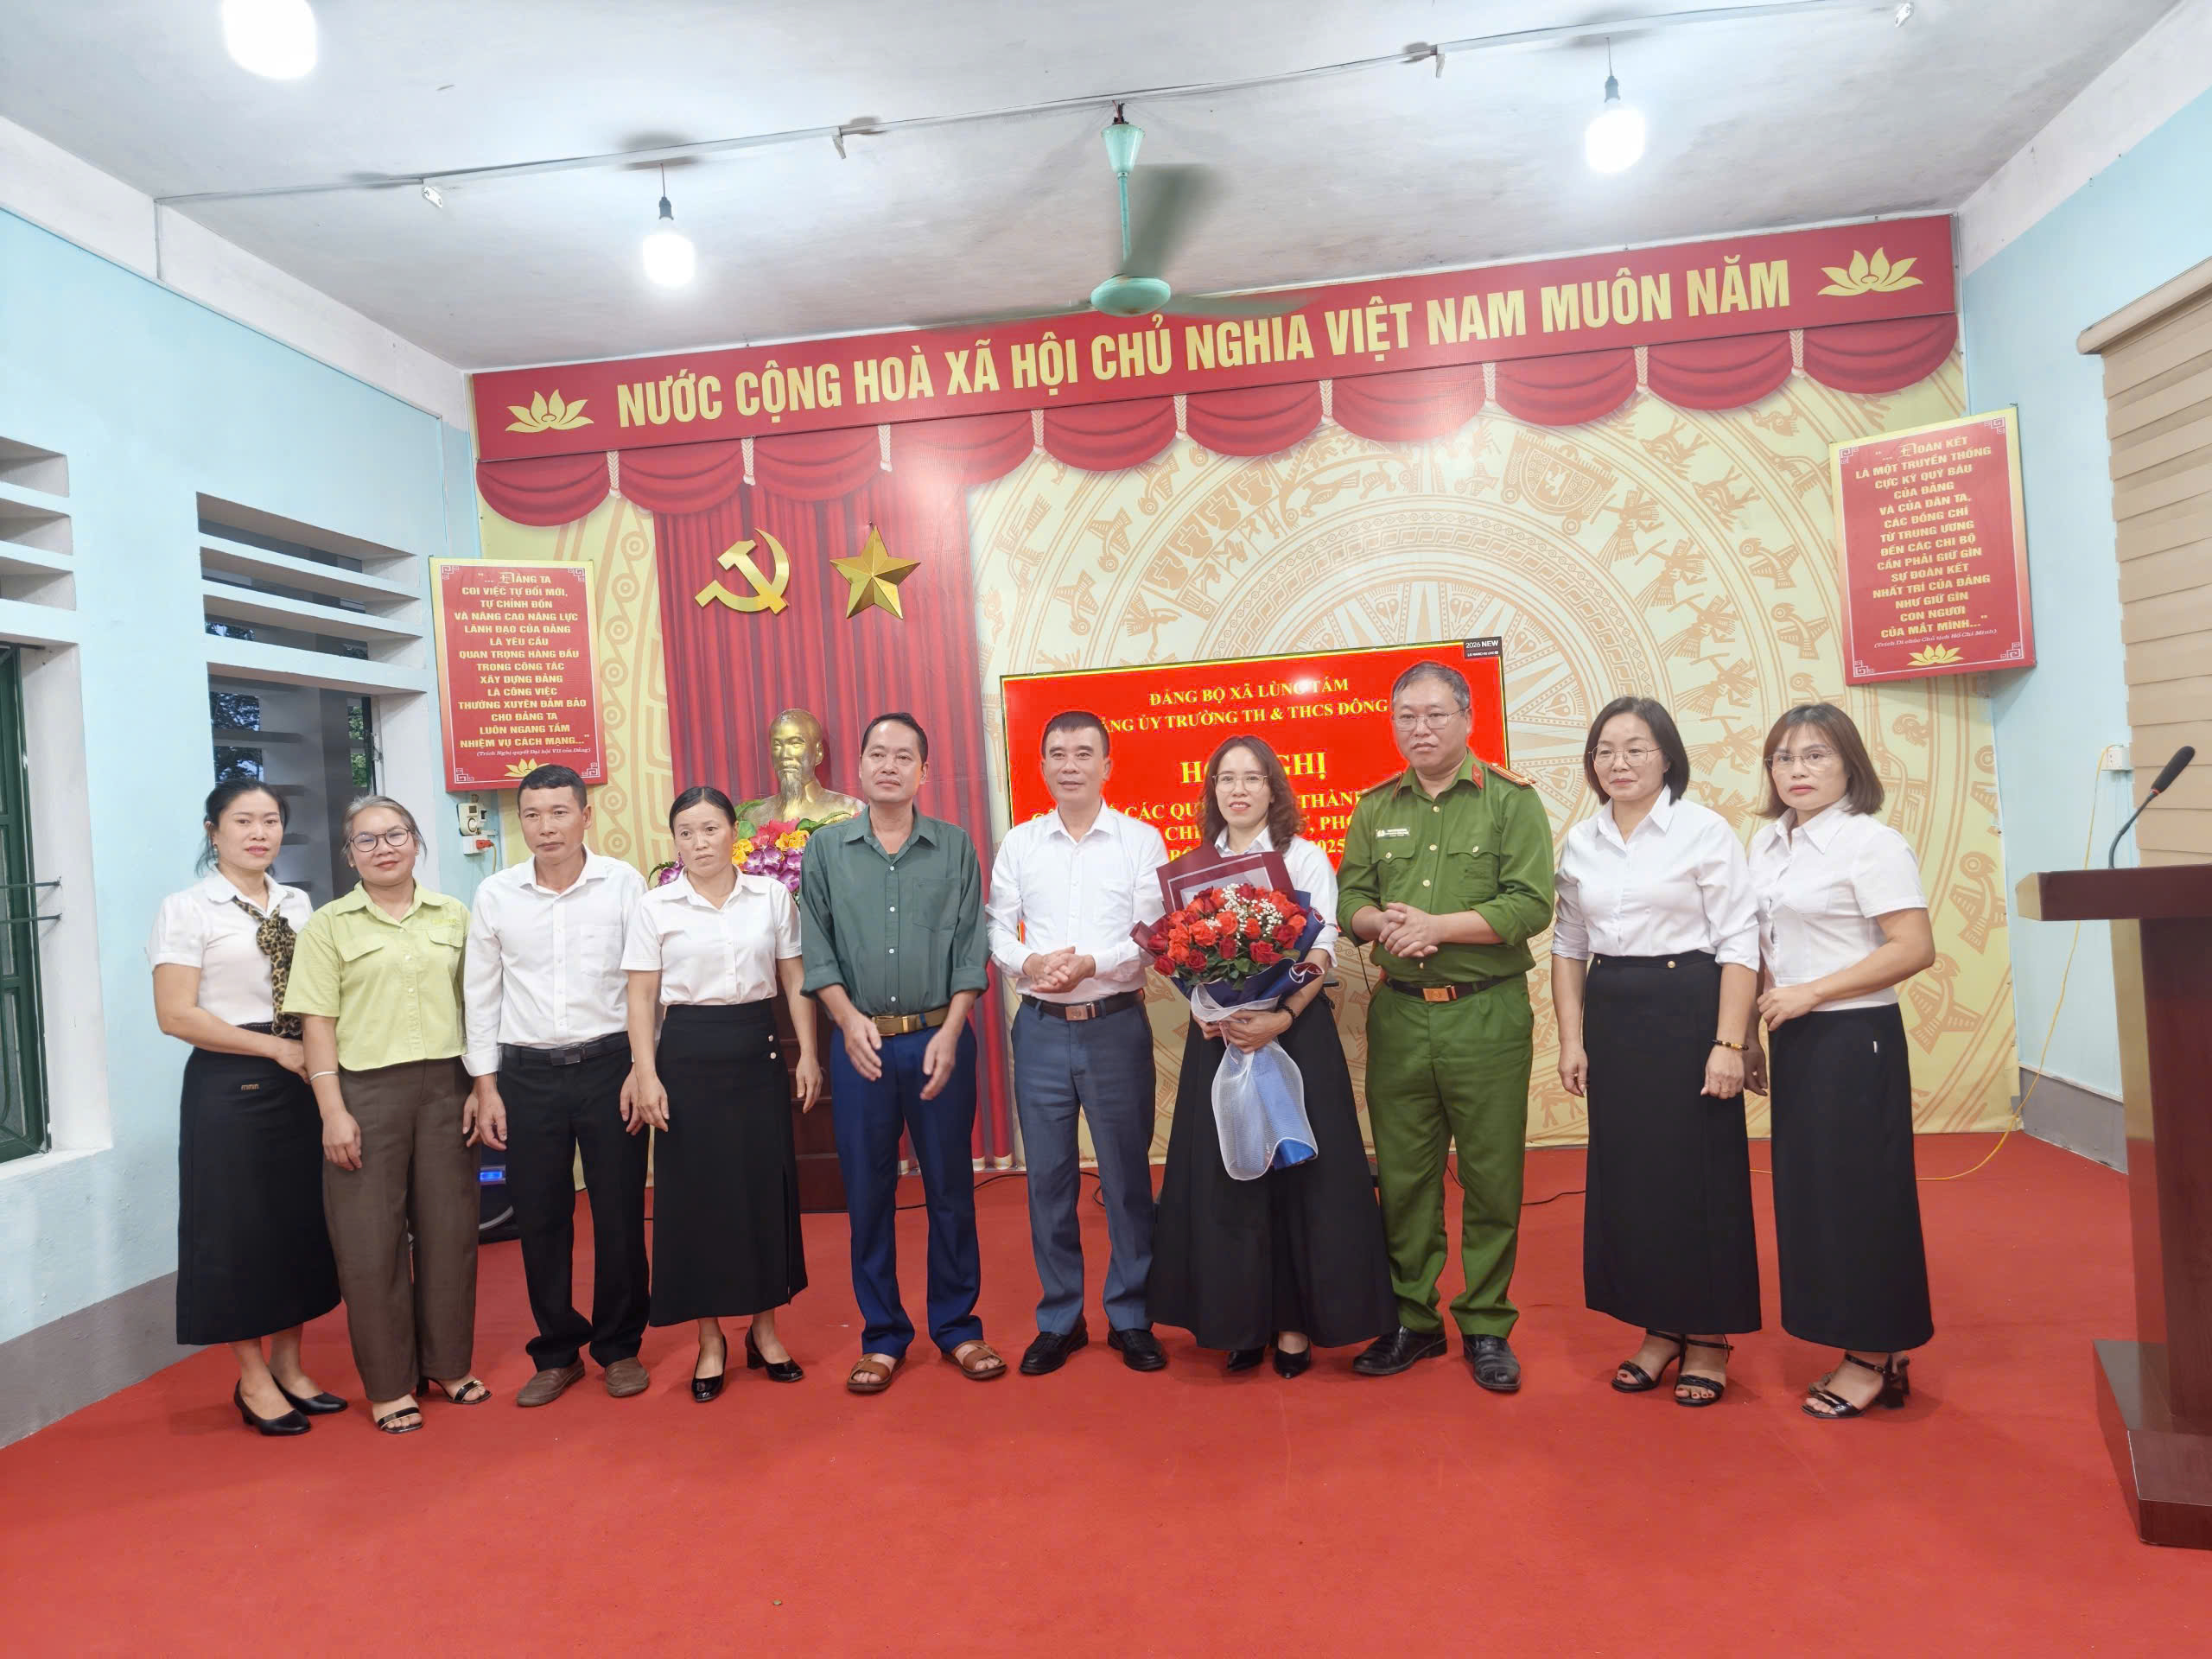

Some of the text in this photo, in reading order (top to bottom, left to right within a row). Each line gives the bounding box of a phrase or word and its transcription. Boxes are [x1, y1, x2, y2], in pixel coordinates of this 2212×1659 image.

[617, 367, 722, 428] NƯỚC
[735, 359, 842, 423] CỘNG
[854, 345, 934, 405] HOÀ
[944, 338, 1000, 396] XÃ
[1010, 331, 1078, 397] HỘI
[1091, 314, 1173, 380] CHỦ
[1324, 296, 1412, 362] VIỆT
[1427, 289, 1527, 346] NAM
[1541, 267, 1673, 334] MUÔN
[1687, 254, 1790, 318] NĂM
[1898, 442, 1942, 459] ĐOÀN
[1855, 469, 1870, 480] LÀ
[1872, 464, 1898, 476] MỘT
[1874, 478, 1898, 489] CỰC
[1893, 481, 1955, 499] CỦA ĐẢNG
[1879, 505, 1895, 516] VÀ
[1897, 499, 1923, 512] CỦA
[1925, 495, 1950, 508] DÂN
[1884, 516, 1908, 529] CÁC
[1948, 505, 1969, 518] CHÍ
[1898, 526, 1937, 540] TRUNG
[1940, 520, 1974, 533] ƯƠNG
[1907, 540, 1932, 552] CÁC
[1936, 537, 1955, 548] CHI
[1959, 532, 1976, 545] BỘ
[1904, 552, 1933, 567] PHẢI
[1936, 550, 1958, 562] GIỮ
[1960, 545, 1982, 558] GÌN
[498, 571, 537, 584] ĐẢNG
[1891, 571, 1908, 583] SỰ
[1910, 566, 1943, 580] ĐOÀN
[1906, 582, 1925, 594] TRÍ
[1929, 578, 1953, 591] CỦA
[1956, 574, 1991, 588] ĐẢNG
[483, 587, 506, 596] VIỆC
[510, 588, 523, 596] TỰ
[480, 600, 494, 609] TỰ
[496, 598, 529, 608] CHỈNH
[1895, 590, 1969, 609] NHƯ GIỮ GÌN
[454, 610, 468, 620] VÀ
[471, 611, 501, 620] NÂNG
[505, 612, 524, 620] CAO
[560, 612, 578, 622] LỰC
[1900, 611, 1924, 622] CON
[495, 625, 517, 634] ĐẠO
[519, 623, 540, 633] CỦA
[543, 623, 571, 633] ĐẢNG
[1880, 626, 1904, 638] CỦA
[490, 637, 502, 645] LÀ
[505, 636, 525, 645] YÊU
[459, 651, 488, 659] QUAN
[491, 650, 525, 659] TRỌNG
[528, 649, 556, 658] HÀNG
[477, 661, 564, 671] TRONG CÔNG TÁC
[480, 673, 563, 684] XÂY DỰNG ĐẢNG
[487, 686, 557, 696] LÀ CÔNG VIỆC
[1149, 689, 1198, 706] ĐẢNG
[1203, 686, 1226, 703] BỘ
[1230, 683, 1254, 699] XÃ
[504, 699, 537, 709] XUYÊN
[541, 697, 563, 708] ĐẢM
[567, 697, 587, 708] BẢO
[491, 711, 558, 721] CHO ĐẢNG TA
[1139, 714, 1162, 730] ỦY
[1166, 709, 1238, 728] TRƯỜNG
[1243, 709, 1265, 722] TH
[1270, 707, 1284, 720] &
[1287, 703, 1333, 719] THCS
[1338, 698, 1388, 715] ĐÔNG
[480, 725, 507, 734] LUÔN
[510, 725, 545, 734] NGANG
[460, 738, 495, 749] NHIỆM
[498, 739, 512, 748] VỤ
[514, 736, 542, 746] CÁCH
